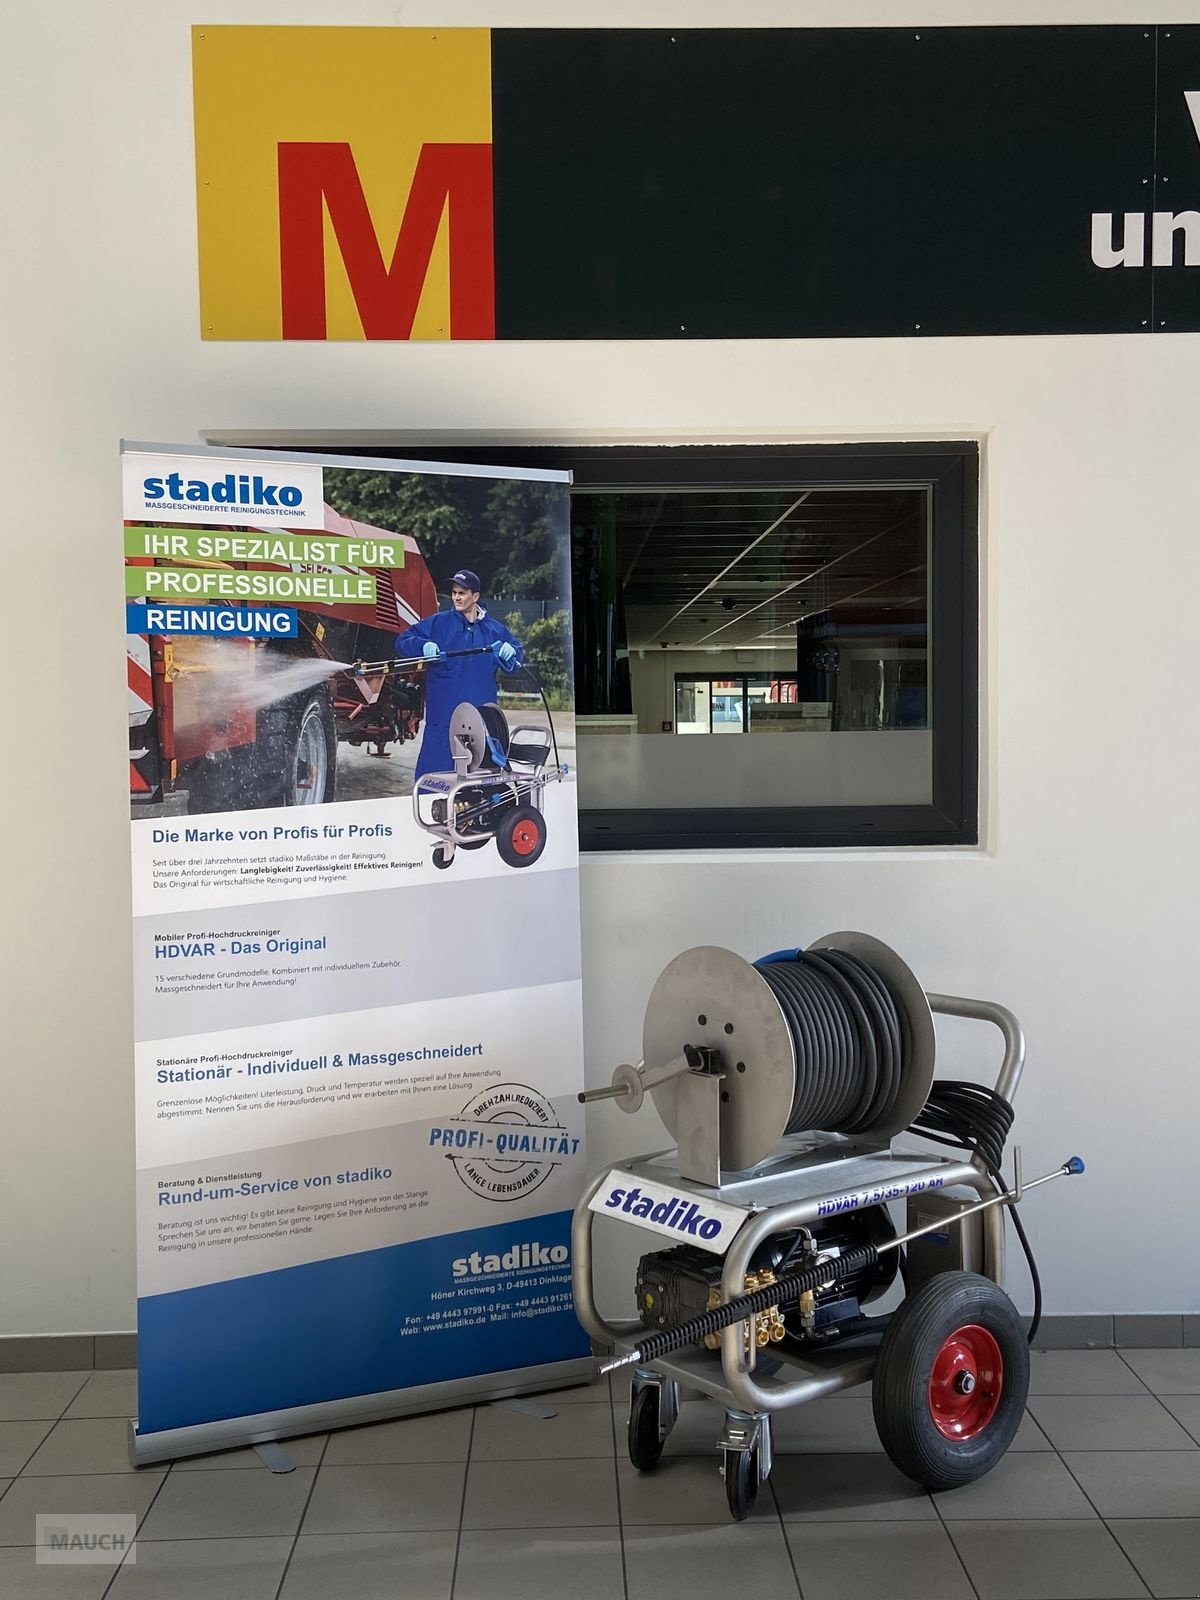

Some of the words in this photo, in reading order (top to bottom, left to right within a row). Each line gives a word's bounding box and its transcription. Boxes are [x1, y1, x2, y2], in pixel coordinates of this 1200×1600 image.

[277, 142, 496, 340] M
[144, 472, 302, 507] stadiko
[145, 502, 228, 513] MASSGESCHNEIDERTE
[230, 507, 305, 517] REINIGUNGSTECHNIK
[144, 535, 189, 556] IHR
[197, 537, 339, 562] SPEZIALIST
[347, 540, 394, 564] FÜR
[145, 571, 372, 598] PROFESSIONELLE
[147, 609, 290, 632] REINIGUNG
[422, 778, 450, 792] stadiko
[152, 830, 179, 843] Die
[185, 828, 233, 842] Marke
[238, 830, 267, 841] von
[273, 826, 318, 840] Profis
[323, 825, 344, 838] für
[348, 824, 392, 838] Profis
[204, 856, 248, 865] Jahrzehnten
[249, 856, 267, 864] setzt
[268, 855, 294, 863] stadiko
[295, 853, 328, 862] Maßstäbe
[240, 865, 293, 876] Langlebigkeit!
[295, 863, 351, 873] Zuverlässigkeit!
[353, 862, 388, 870] Effektives
[390, 860, 423, 870] Reinigen!
[168, 879, 198, 889] Original
[212, 877, 264, 886] wirtschaftliche
[266, 876, 301, 885] Reinigung
[154, 933, 184, 941] Mobiler
[186, 928, 280, 940] Profi-Hochdruckreiniger
[155, 943, 215, 958] HDVAR
[231, 941, 260, 954] Das
[266, 937, 326, 955] Original
[166, 972, 215, 982] verschiedene
[216, 968, 270, 979] Grundmodelle.
[271, 966, 310, 975] Kombiniert
[311, 965, 322, 973] mit
[324, 962, 370, 972] individuellem
[154, 982, 222, 994] Massgeschneidert
[251, 977, 296, 987] Anwendung!
[156, 1056, 198, 1066] Stationäre
[200, 1049, 294, 1063] Profi-Hochdruckreiniger
[157, 1065, 232, 1083] Stationär
[247, 1055, 326, 1075] Individuell
[332, 1054, 343, 1067] &
[348, 1043, 482, 1066] Massgeschneidert
[156, 1097, 203, 1107] Grenzenlose
[204, 1091, 258, 1104] Möglichkeiten!
[260, 1088, 304, 1098] Literleistung,
[306, 1085, 326, 1094] Druck
[328, 1083, 342, 1092] und
[343, 1080, 382, 1091] Temperatur
[383, 1078, 408, 1087] werden
[408, 1075, 434, 1086] speziell
[435, 1074, 446, 1082] auf
[462, 1070, 501, 1080] Anwendung
[156, 1107, 203, 1119] abgestimmt.
[205, 1105, 234, 1114] Nennen
[276, 1096, 335, 1107] Herausforderung
[336, 1093, 350, 1101] und
[364, 1089, 398, 1098] erarbeiten
[400, 1087, 411, 1095] mit
[474, 1094, 548, 1122] DREHZAHLREDUZIERT
[157, 1179, 195, 1188] Beratung
[205, 1172, 262, 1183] Dienstleistung
[158, 1178, 298, 1205] Rund-um-Service
[303, 1176, 331, 1188] von
[336, 1166, 392, 1184] stadiko
[464, 1163, 486, 1188] LANGE
[487, 1168, 541, 1192] LEBENSDAUER
[158, 1220, 192, 1230] Beratung
[194, 1217, 203, 1226] ist
[219, 1211, 248, 1222] wichtig!
[259, 1208, 274, 1219] gibt
[276, 1207, 295, 1215] keine
[296, 1203, 331, 1212] Reinigung
[333, 1199, 347, 1208] und
[348, 1197, 377, 1207] Hygiene
[405, 1190, 428, 1199] Stange
[604, 1188, 722, 1240] stadiko
[817, 1194, 858, 1216] HDVAR
[158, 1230, 193, 1242] Sprechen
[195, 1228, 206, 1236] Sie
[235, 1223, 247, 1231] wir
[248, 1220, 276, 1229] beraten
[314, 1213, 335, 1222] Legen
[364, 1204, 407, 1214] Anforderung
[418, 1200, 428, 1208] die
[158, 1242, 196, 1252] Reinigung
[207, 1237, 232, 1246] unsere
[233, 1230, 287, 1244] professionellen
[452, 1242, 568, 1277] stadiko
[431, 1291, 455, 1300] Höner
[457, 1285, 495, 1296] Kirchweg
[497, 1283, 504, 1292] 3,
[506, 1278, 537, 1289] D-49413
[539, 1275, 572, 1285] Dinklage
[400, 1326, 420, 1336] Web:
[422, 1316, 486, 1332] www.stadiko.de
[490, 1312, 508, 1322] Mail:
[511, 1303, 572, 1318] info@stadiko.de
[405, 1317, 423, 1325] Fon:
[426, 1312, 440, 1321] +49
[442, 1309, 461, 1319] 4443
[463, 1304, 494, 1316] 97991-0
[495, 1303, 512, 1311] Fax:
[515, 1298, 528, 1308] +49
[530, 1295, 548, 1305] 4443
